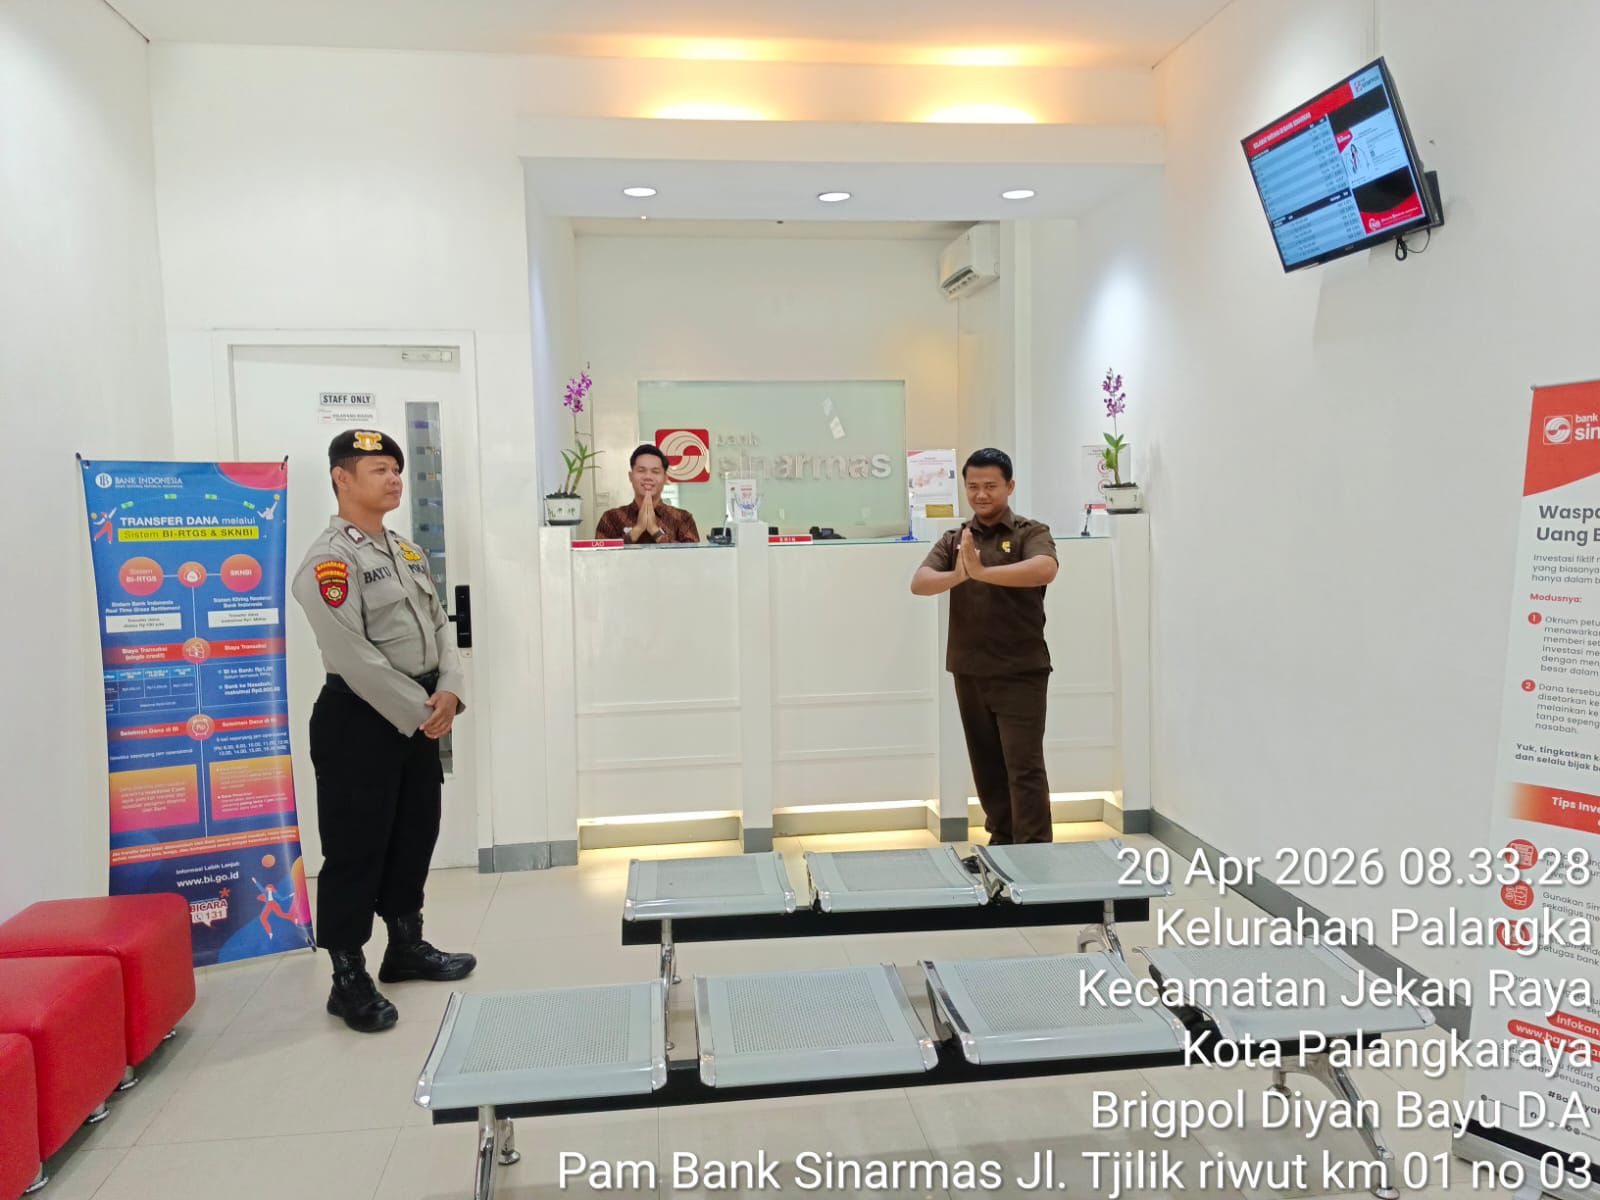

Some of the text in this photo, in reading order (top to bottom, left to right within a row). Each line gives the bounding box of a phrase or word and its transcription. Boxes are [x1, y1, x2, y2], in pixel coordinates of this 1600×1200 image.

[322, 394, 371, 404] STAFF ONLY
[1575, 412, 1599, 423] bank
[718, 450, 892, 481] sinarmas
[114, 476, 184, 485] BANK INDONESIA
[120, 516, 256, 526] TRANSFER DANA melalui
[124, 528, 253, 539] Sistem BI-RTGS & SKNBI
[1536, 527, 1588, 546] Uang
[1533, 554, 1575, 563] Investasi
[363, 566, 391, 584] BAYU
[1532, 565, 1600, 576] yang biasanya
[1531, 574, 1562, 585] hanya
[1564, 575, 1593, 584] dalam
[1530, 593, 1583, 604] Modusnya:
[1545, 616, 1578, 625] Oknum
[1543, 636, 1585, 645] memberi
[1542, 645, 1583, 655] investasi
[1541, 655, 1578, 665] dengan
[1540, 664, 1599, 677] besar dalam
[1538, 683, 1564, 693] Dana
[1537, 693, 1587, 705] disetorkan
[1537, 704, 1599, 717] melainkan ke
[1536, 712, 1565, 723] tanpa
[1516, 743, 1537, 753] Yuk,
[1539, 746, 1592, 761] tingkatkan
[1515, 752, 1534, 761] dan
[1537, 756, 1566, 766] selalu
[1567, 760, 1590, 770] bijak
[1552, 796, 1576, 810] Tips
[176, 871, 239, 887] www.bi.go.id
[1542, 891, 1584, 907] Gunakan
[206, 910, 223, 920] 131
[1538, 945, 1600, 966] petugas bank
[1567, 1064, 1593, 1080] fraud
